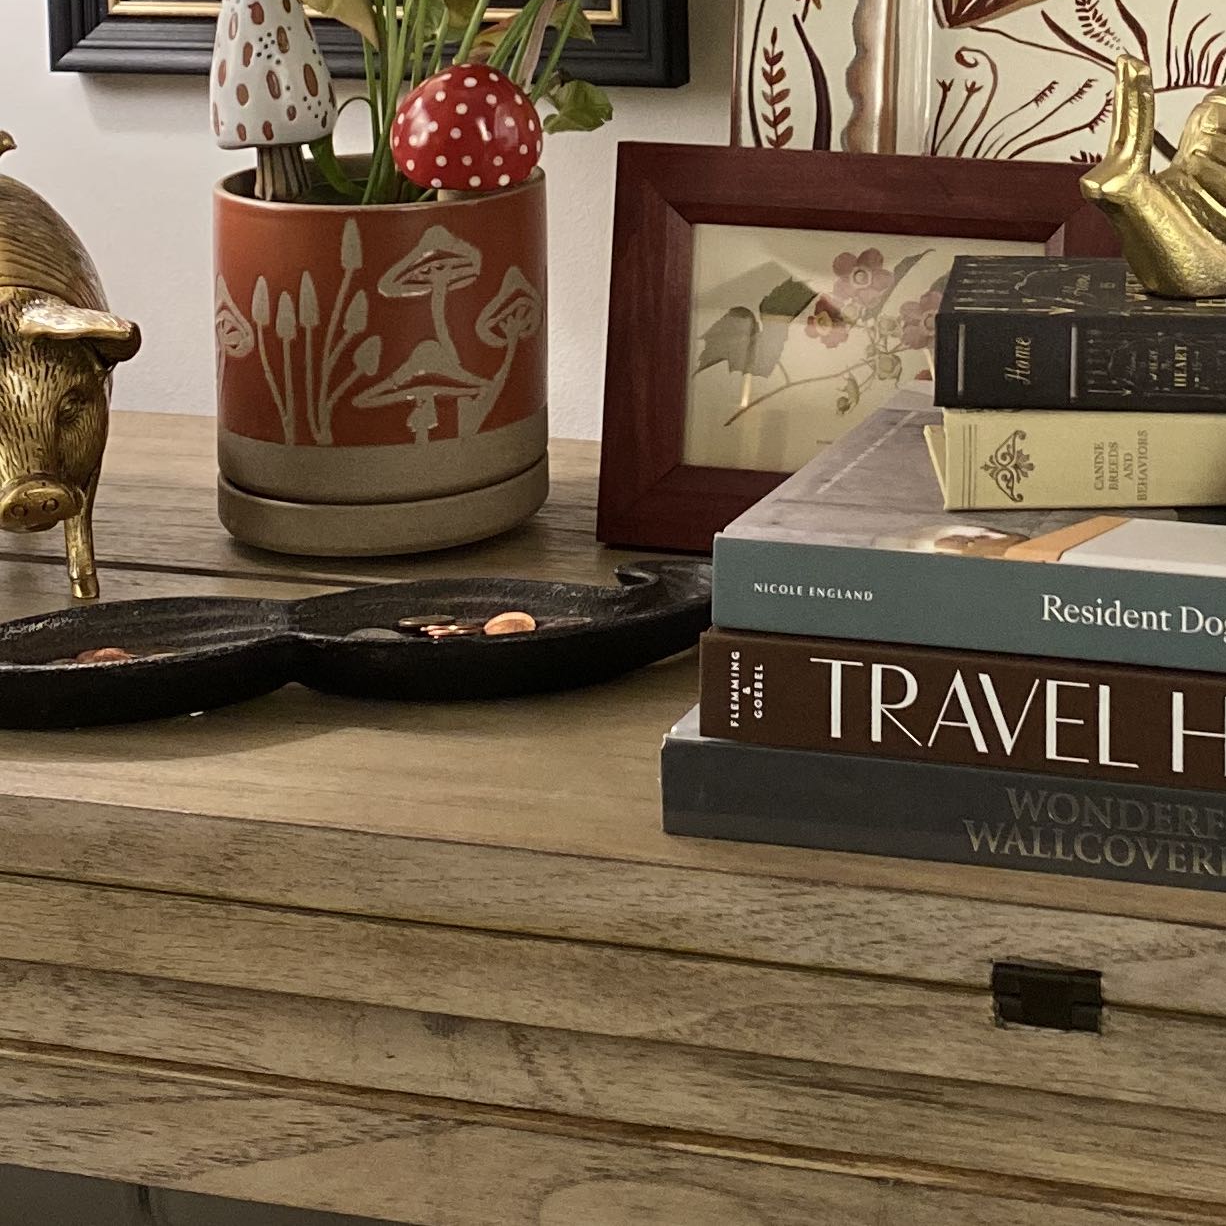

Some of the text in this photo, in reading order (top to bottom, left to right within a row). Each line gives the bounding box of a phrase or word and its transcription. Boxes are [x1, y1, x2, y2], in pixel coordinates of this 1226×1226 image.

[1004, 336, 1032, 385] Home
[1173, 344, 1188, 387] HEART
[1094, 441, 1105, 491] CANINE
[1108, 441, 1119, 491] BREEDS
[1123, 452, 1133, 480] AND
[1136, 429, 1149, 502] BEHAVIORS
[753, 582, 874, 602] NICOLE ENGLAND
[1041, 593, 1173, 632] Resident
[730, 651, 740, 728] FLEMMING
[753, 663, 764, 719] GOEBEL
[810, 657, 1139, 769] TRAVEL
